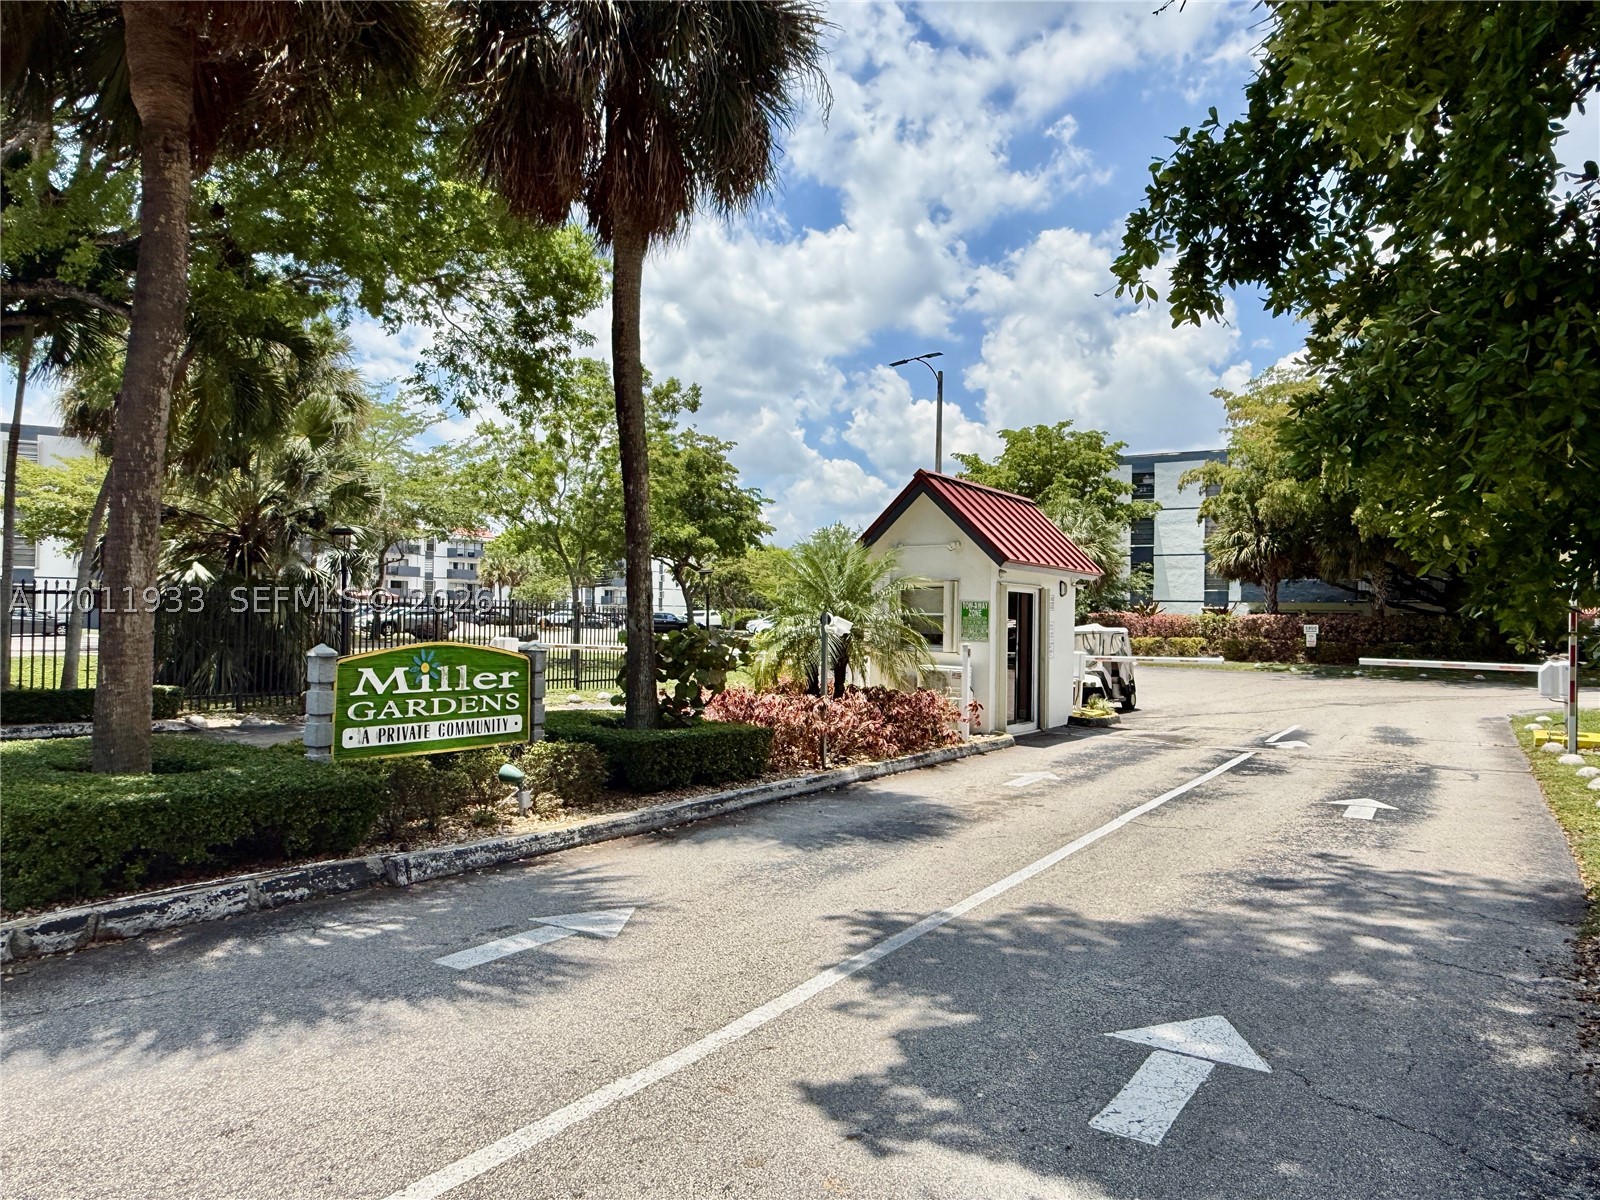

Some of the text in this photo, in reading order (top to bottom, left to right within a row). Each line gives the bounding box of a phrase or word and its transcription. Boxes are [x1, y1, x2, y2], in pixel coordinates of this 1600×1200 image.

[349, 665, 520, 696] Miller
[347, 692, 520, 721] GARDENS
[361, 717, 509, 745] A PRIVATE COMMUNITY
